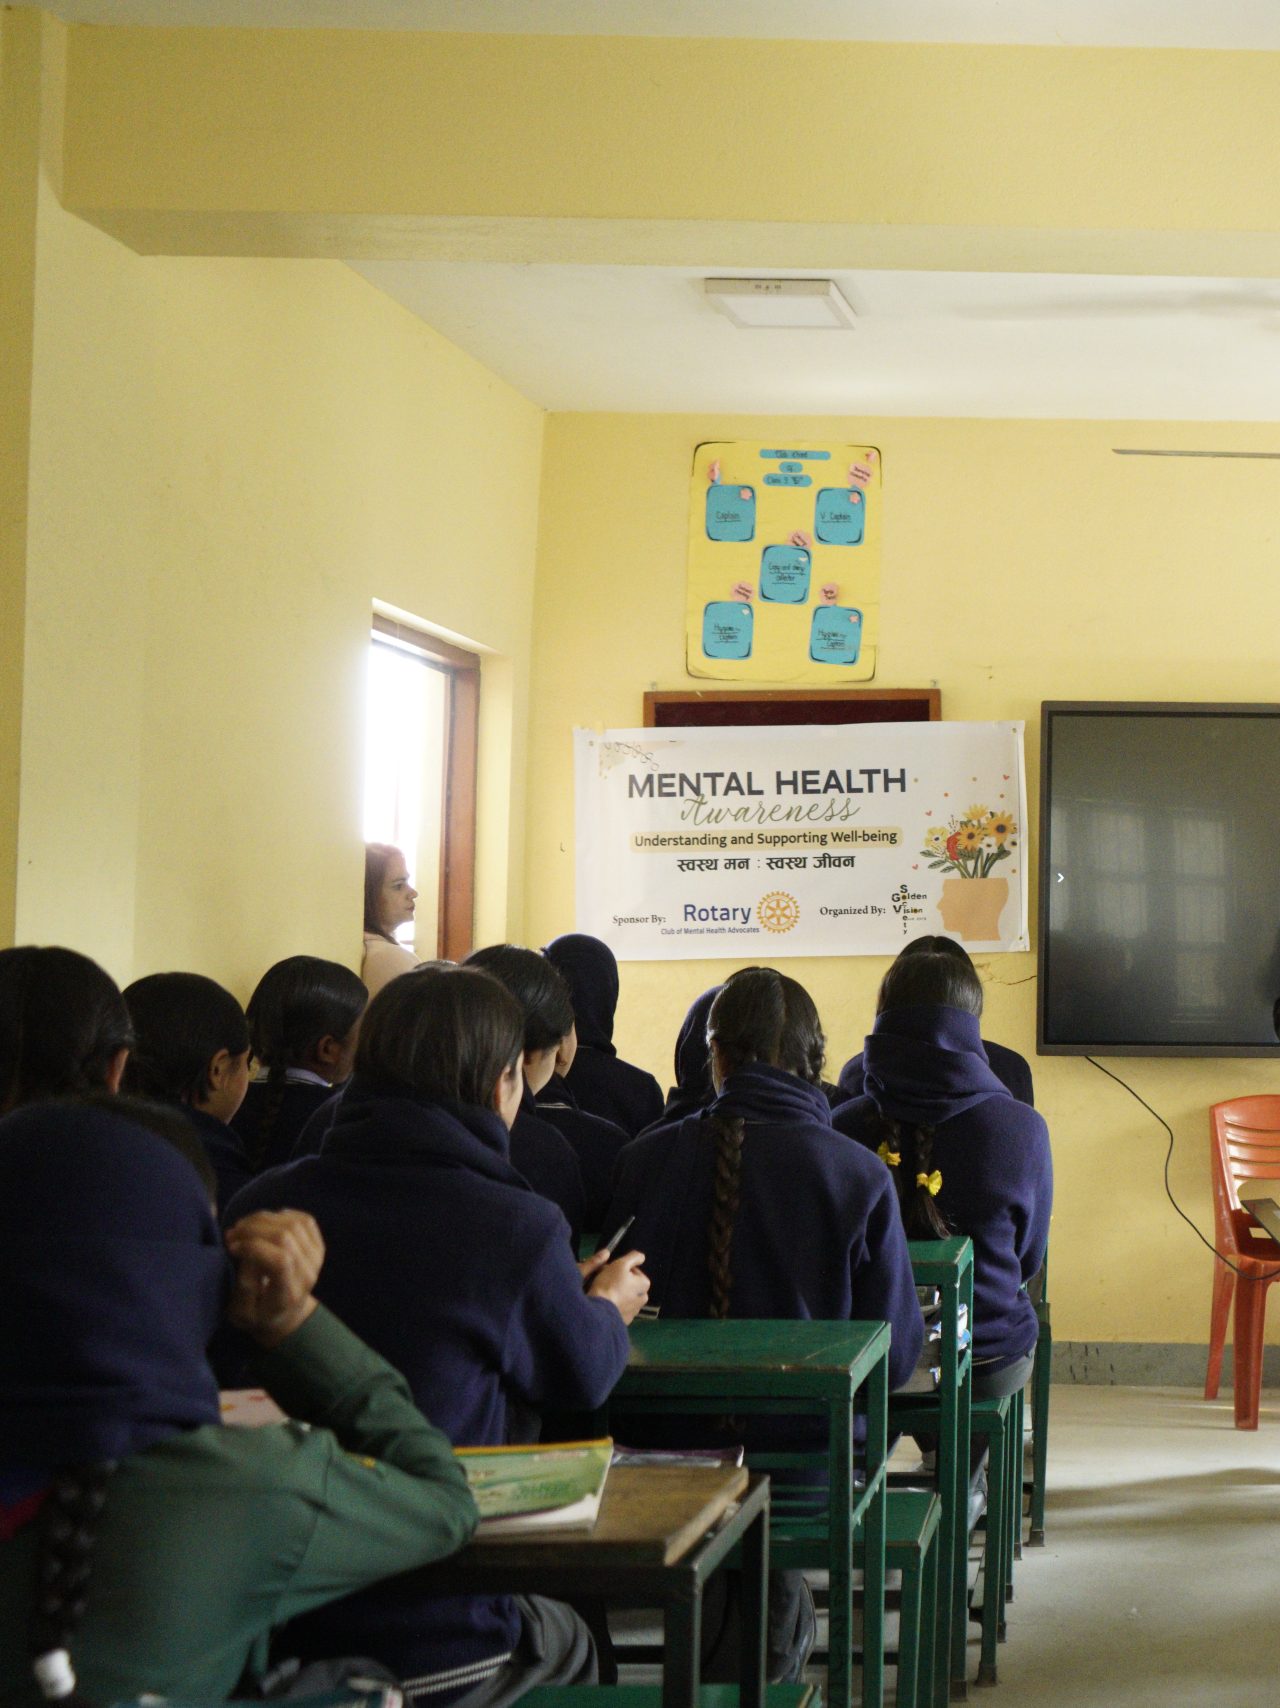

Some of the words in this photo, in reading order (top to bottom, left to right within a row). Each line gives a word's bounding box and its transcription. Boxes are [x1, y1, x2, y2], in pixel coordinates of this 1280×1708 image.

[715, 510, 740, 521] Captain
[830, 512, 852, 521] Captain
[628, 771, 764, 798] MENTAL
[775, 768, 907, 795] HEALTH
[680, 793, 861, 826] Awareness
[635, 833, 727, 848] Understanding
[730, 833, 754, 845] and
[757, 831, 828, 847] Supporting
[830, 829, 898, 845] Well-being
[677, 858, 718, 872] स्वस्थ
[724, 858, 750, 870] मन
[766, 856, 808, 870] स्वस्थ
[813, 853, 856, 869] जीवन
[891, 893, 928, 902] Golden
[684, 903, 752, 924] Rotary
[820, 905, 869, 918] Organized
[871, 905, 886, 916] By:
[893, 904, 923, 914] Vision
[612, 915, 649, 926] Sponsor
[651, 914, 667, 925] By:
[676, 927, 683, 935] of
[706, 926, 726, 934] Health
[727, 926, 760, 934] Advocates
